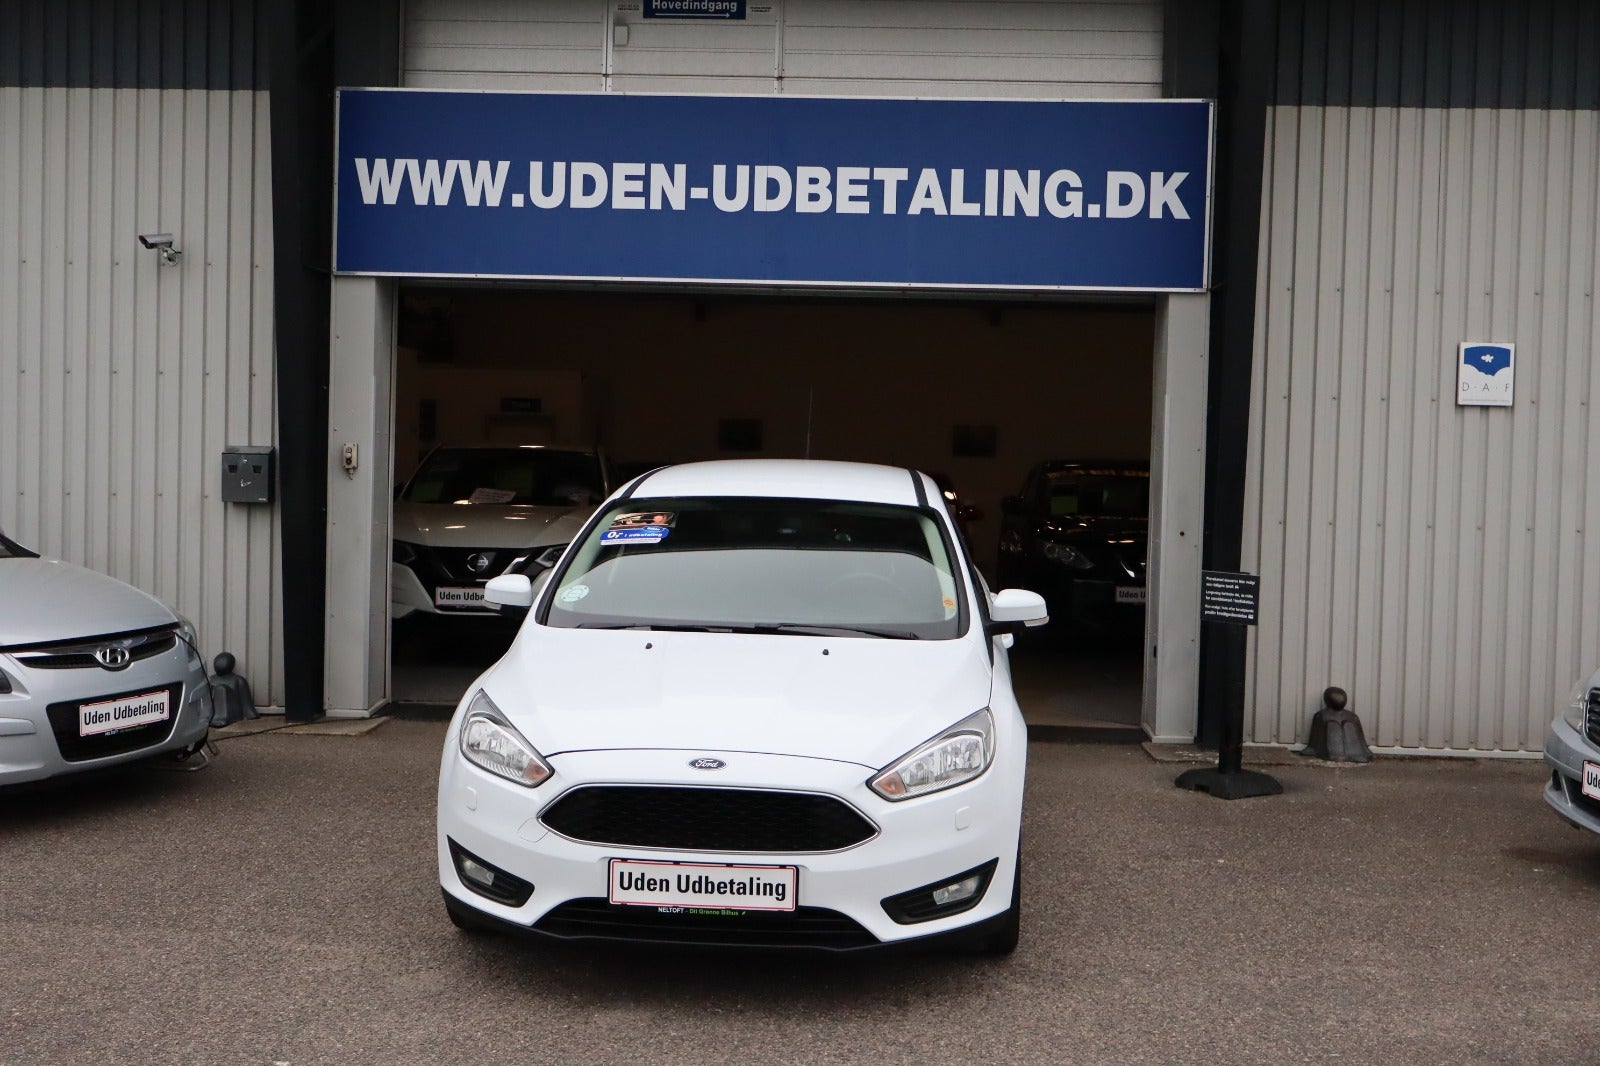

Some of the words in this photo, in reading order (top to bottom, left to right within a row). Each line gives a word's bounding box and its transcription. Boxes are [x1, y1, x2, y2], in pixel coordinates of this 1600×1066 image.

[652, 0, 737, 12] Hovedindgang
[354, 158, 1191, 220] WWW.UDEN-UDBETALING.DK
[439, 591, 461, 600] Uden
[83, 709, 111, 726] Uden
[113, 700, 165, 721] Udbetaling
[695, 759, 719, 768] Ford
[619, 871, 670, 893] Uden
[677, 874, 786, 901] Udbetaling
